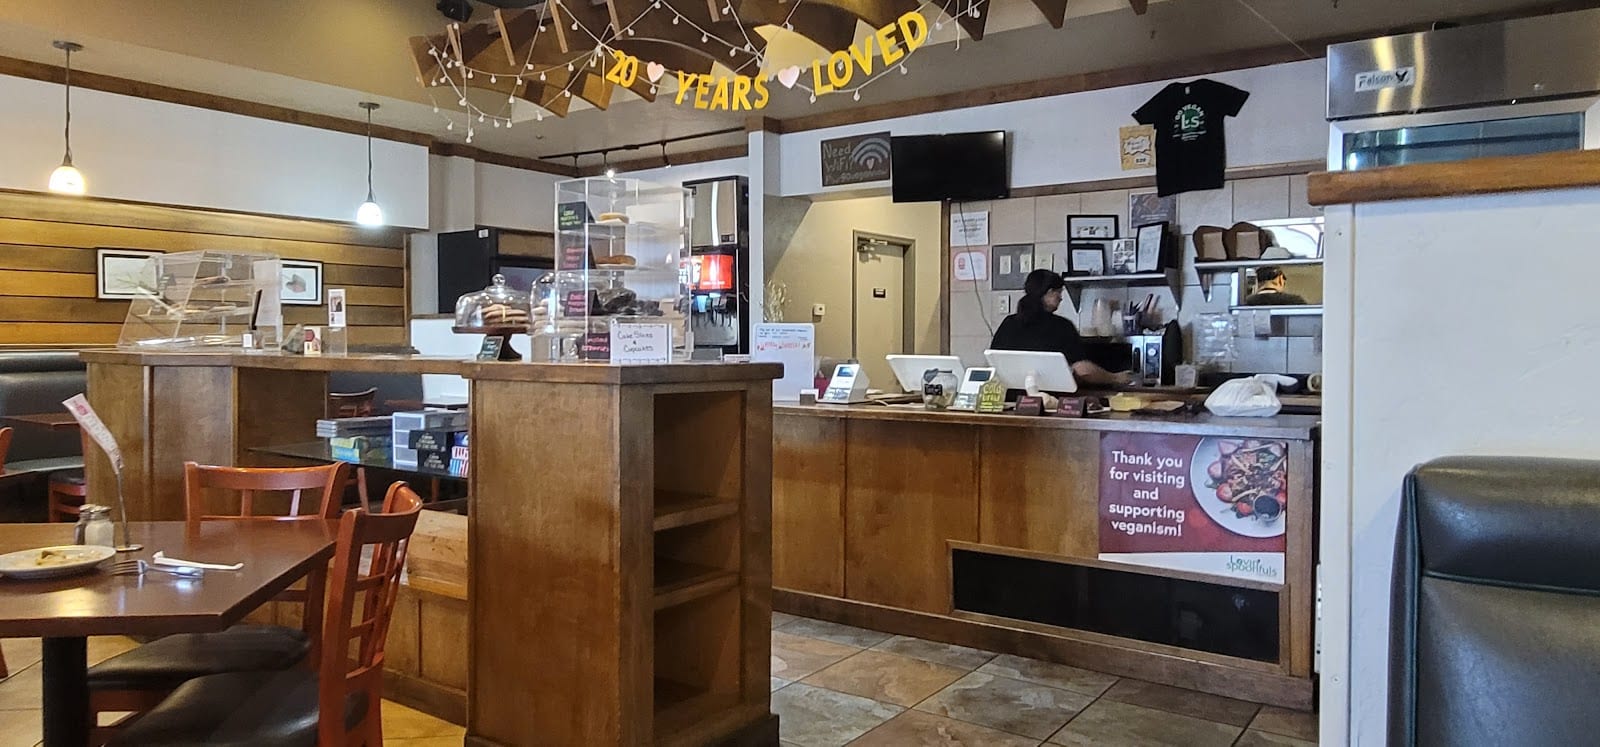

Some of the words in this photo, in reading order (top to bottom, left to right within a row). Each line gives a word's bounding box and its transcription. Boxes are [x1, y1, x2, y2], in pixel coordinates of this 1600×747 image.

[606, 50, 638, 88] 20
[674, 70, 769, 111] YEARS
[812, 11, 928, 96] LOVED
[1182, 103, 1204, 118] VEGAN
[823, 142, 852, 161] Need
[617, 330, 633, 340] Cake
[1112, 450, 1152, 466] Thank
[1157, 457, 1183, 470] you
[1109, 466, 1129, 480] for
[1133, 469, 1185, 488] visiting
[1133, 487, 1159, 500] and
[1109, 503, 1185, 523] supporting
[1111, 521, 1182, 537] veganism!
